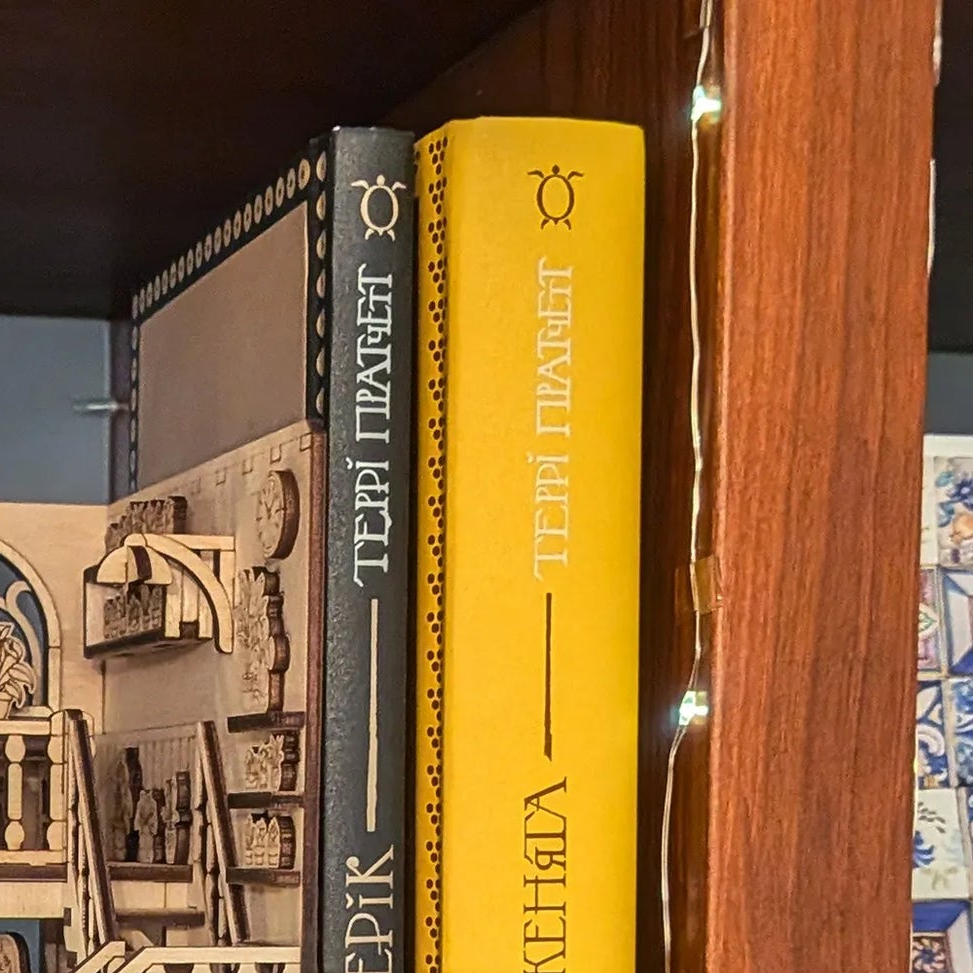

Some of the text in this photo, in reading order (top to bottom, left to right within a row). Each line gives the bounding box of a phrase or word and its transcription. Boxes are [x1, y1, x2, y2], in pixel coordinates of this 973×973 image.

[346, 262, 394, 588] ТЕРРІ ПРАТЧЕТТ
[528, 257, 574, 580] ТЕРРІ ПРАТЧЕТТ
